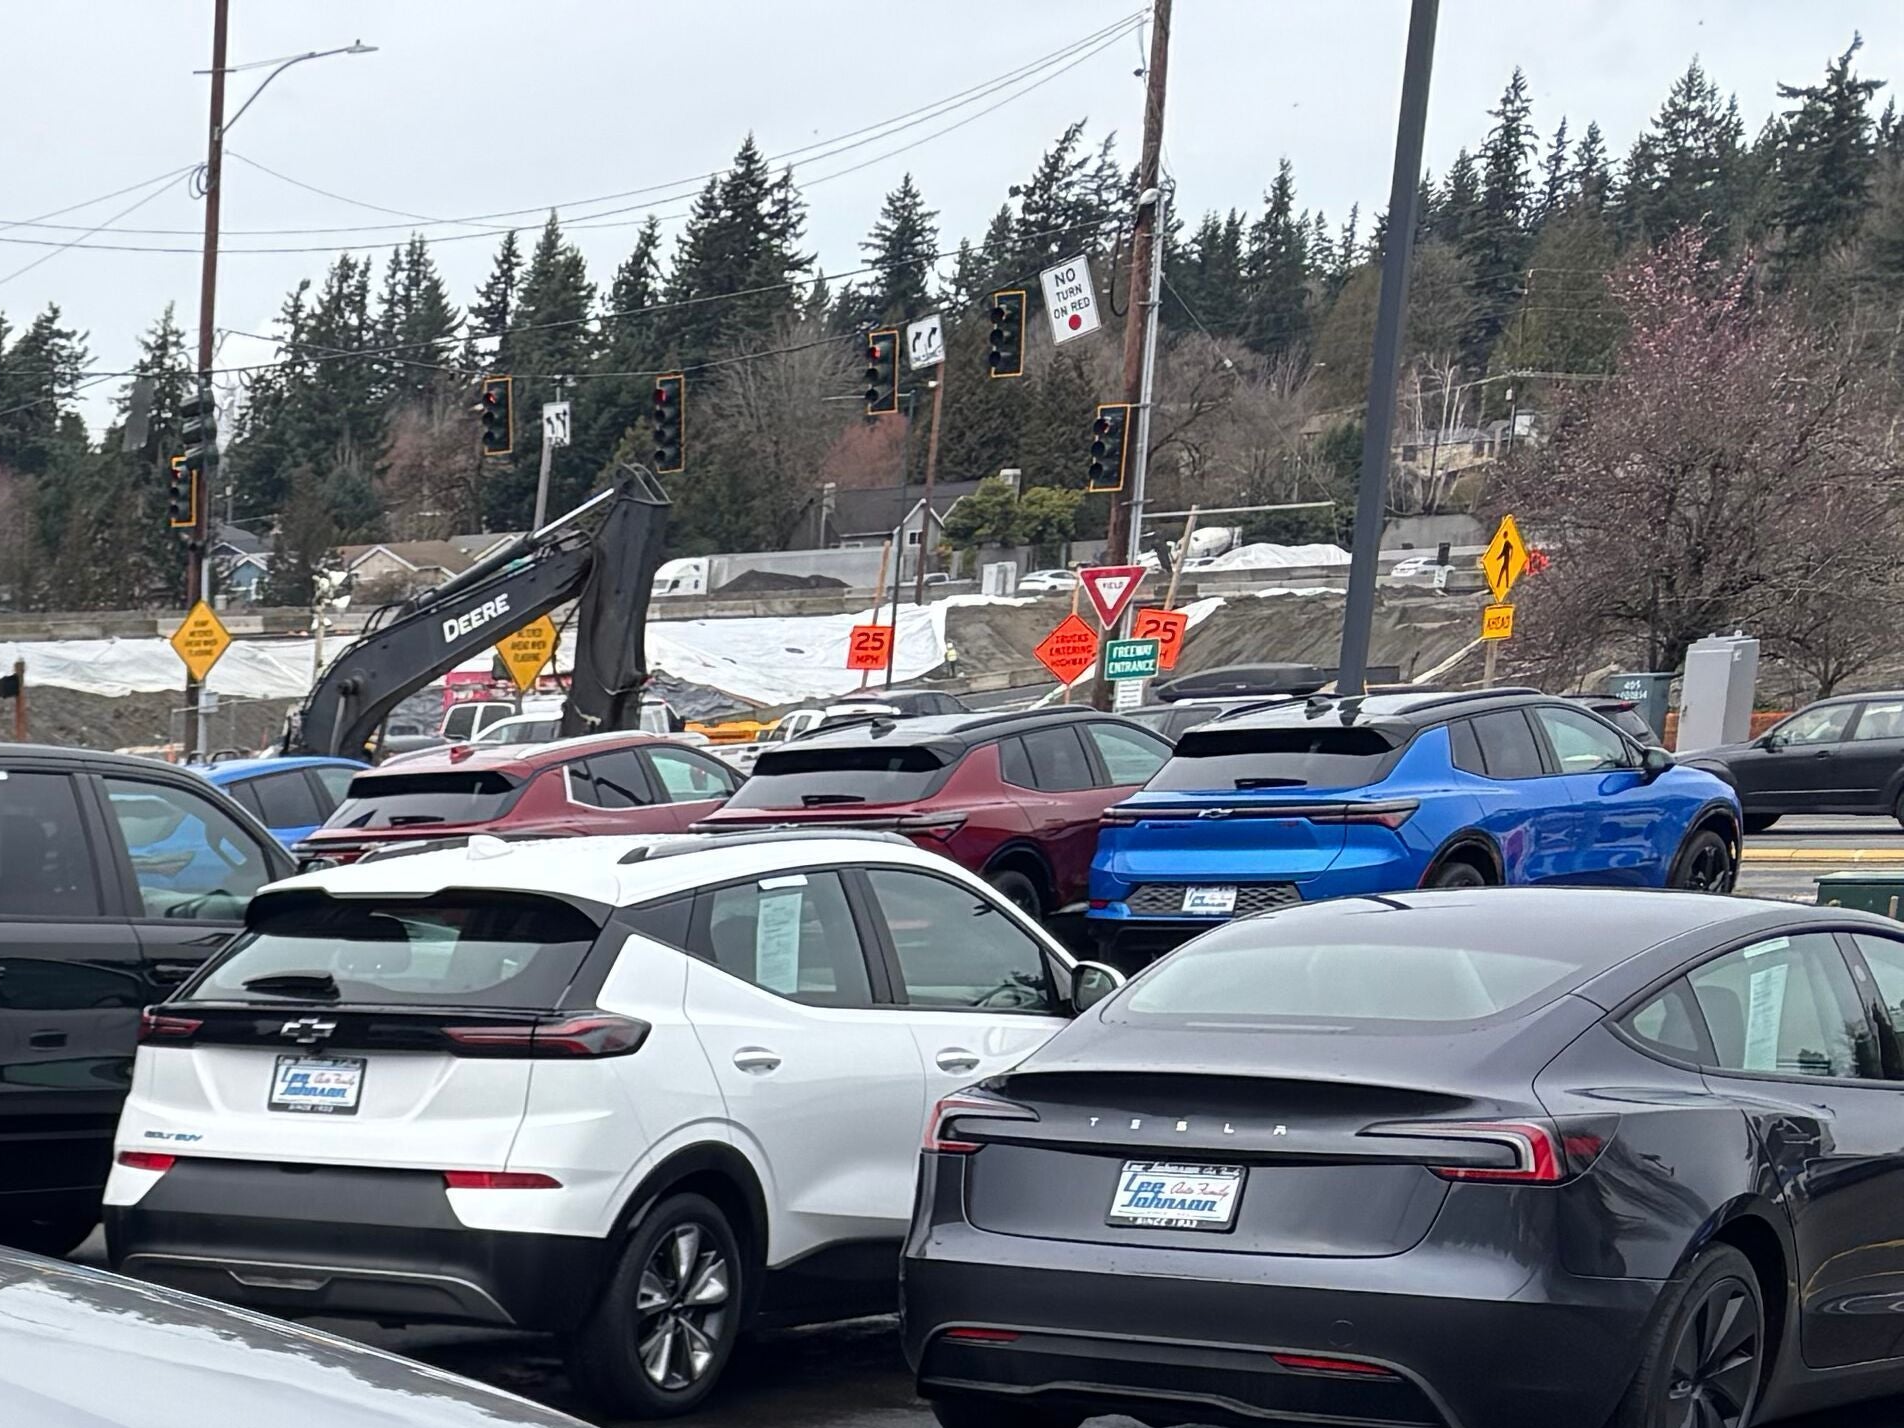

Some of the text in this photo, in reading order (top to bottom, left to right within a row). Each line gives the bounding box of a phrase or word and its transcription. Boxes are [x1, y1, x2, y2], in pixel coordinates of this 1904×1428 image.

[1054, 268, 1076, 287] NO
[1056, 283, 1082, 302] TURN
[1053, 297, 1090, 319] ON RED
[1102, 581, 1124, 590] YIELD
[442, 593, 510, 643] DEERE
[1487, 615, 1510, 630] AHEAD
[1055, 633, 1089, 644] TRUCKS
[1142, 619, 1178, 644] 25
[855, 632, 884, 651] 25
[856, 655, 879, 664] MPH
[1112, 645, 1153, 659] FREEWAY
[1108, 659, 1155, 674] ENTRANCE
[143, 1130, 203, 1141] BOLT EUV
[1089, 1117, 1288, 1136] TESLA
[1123, 1173, 1167, 1194] Lee
[1120, 1193, 1217, 1211] Johnson
[1136, 1217, 1167, 1227] SINCE
